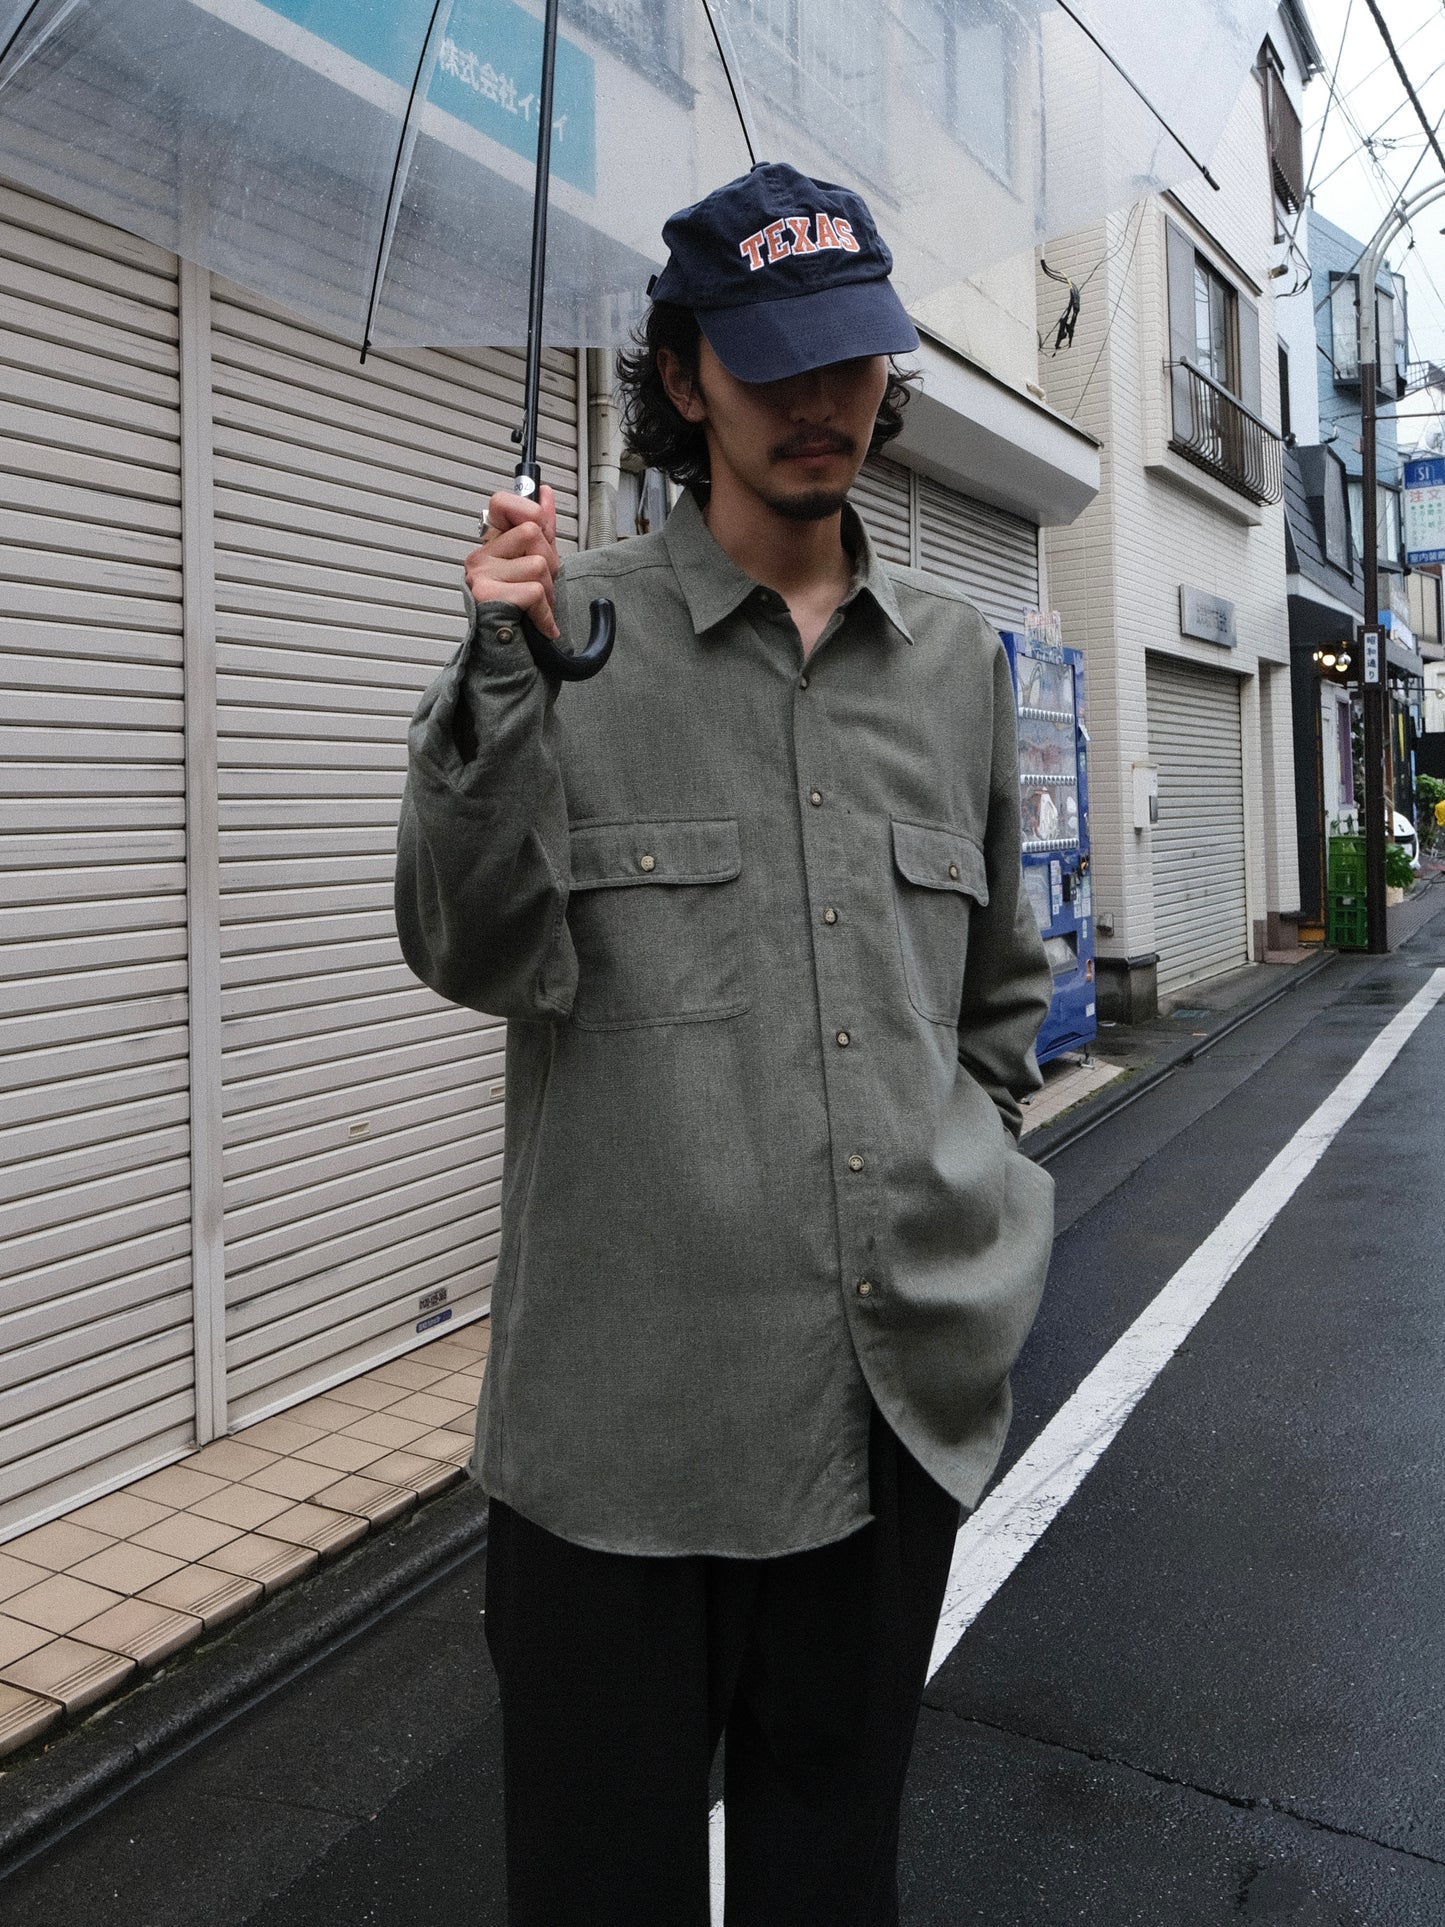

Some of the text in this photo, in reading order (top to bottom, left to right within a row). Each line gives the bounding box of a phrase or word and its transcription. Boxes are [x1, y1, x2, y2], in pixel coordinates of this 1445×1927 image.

[439, 37, 568, 142] 株式会社イイ
[739, 212, 860, 272] TEXAS
[1366, 635, 1377, 680] 昭和通り
